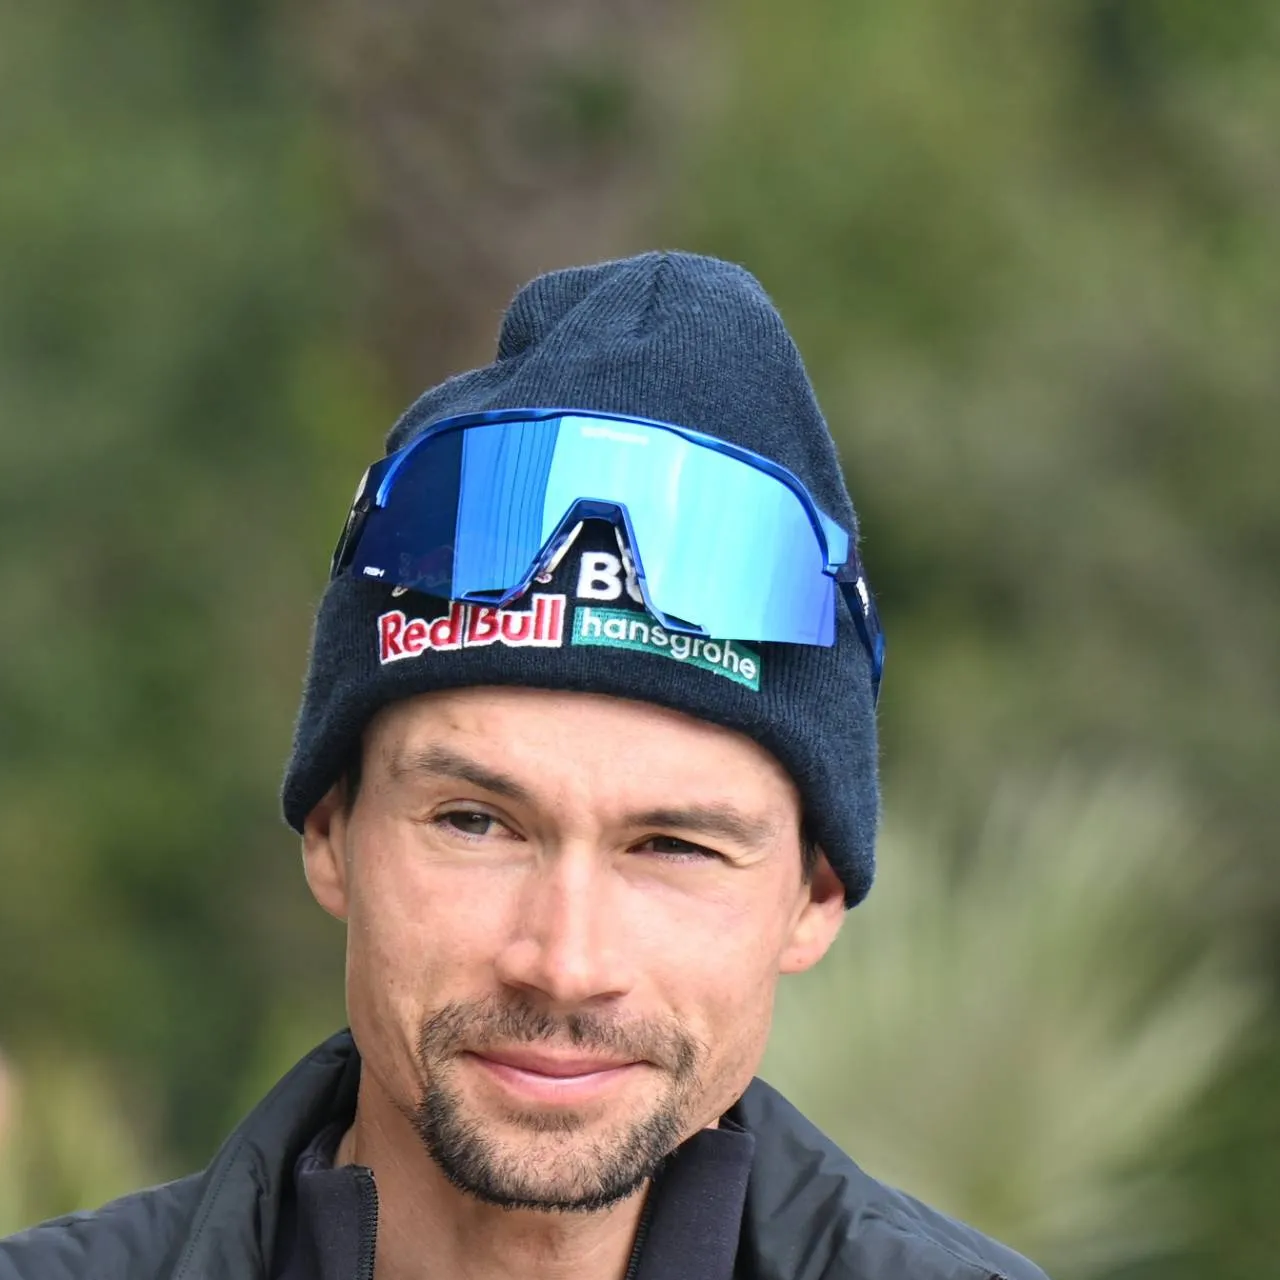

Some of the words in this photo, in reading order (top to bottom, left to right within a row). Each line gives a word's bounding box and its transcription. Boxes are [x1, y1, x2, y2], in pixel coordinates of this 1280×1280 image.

[378, 600, 462, 665] Red
[464, 594, 566, 648] Bull
[581, 606, 757, 680] hansgrohe
